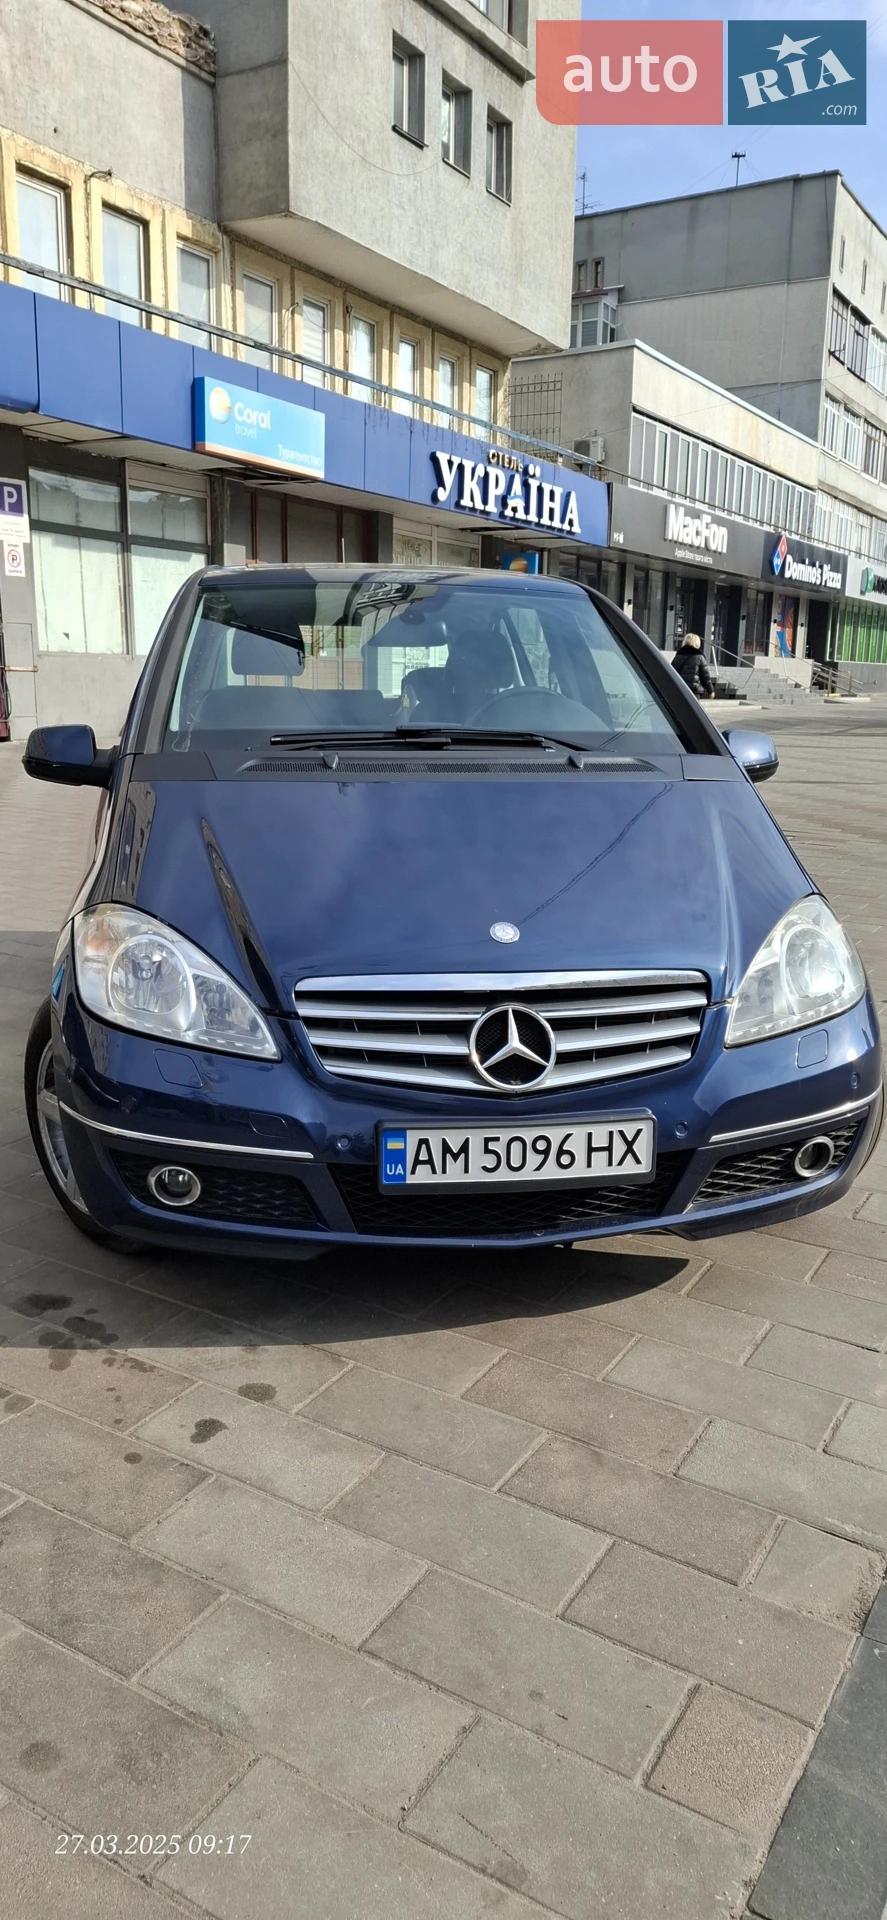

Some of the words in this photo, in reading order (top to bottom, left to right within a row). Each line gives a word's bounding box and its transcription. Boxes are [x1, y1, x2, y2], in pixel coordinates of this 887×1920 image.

[234, 402, 271, 430] Coral
[235, 423, 258, 439] travel
[3, 486, 18, 512] P
[433, 451, 581, 534] УКРАЇНА
[664, 503, 728, 554] MacFon
[784, 554, 822, 585] Domino's
[822, 564, 842, 589] Pizza
[410, 1137, 470, 1176] AM
[480, 1132, 576, 1174] 5096
[586, 1127, 644, 1169] HX
[386, 1163, 404, 1176] UA
